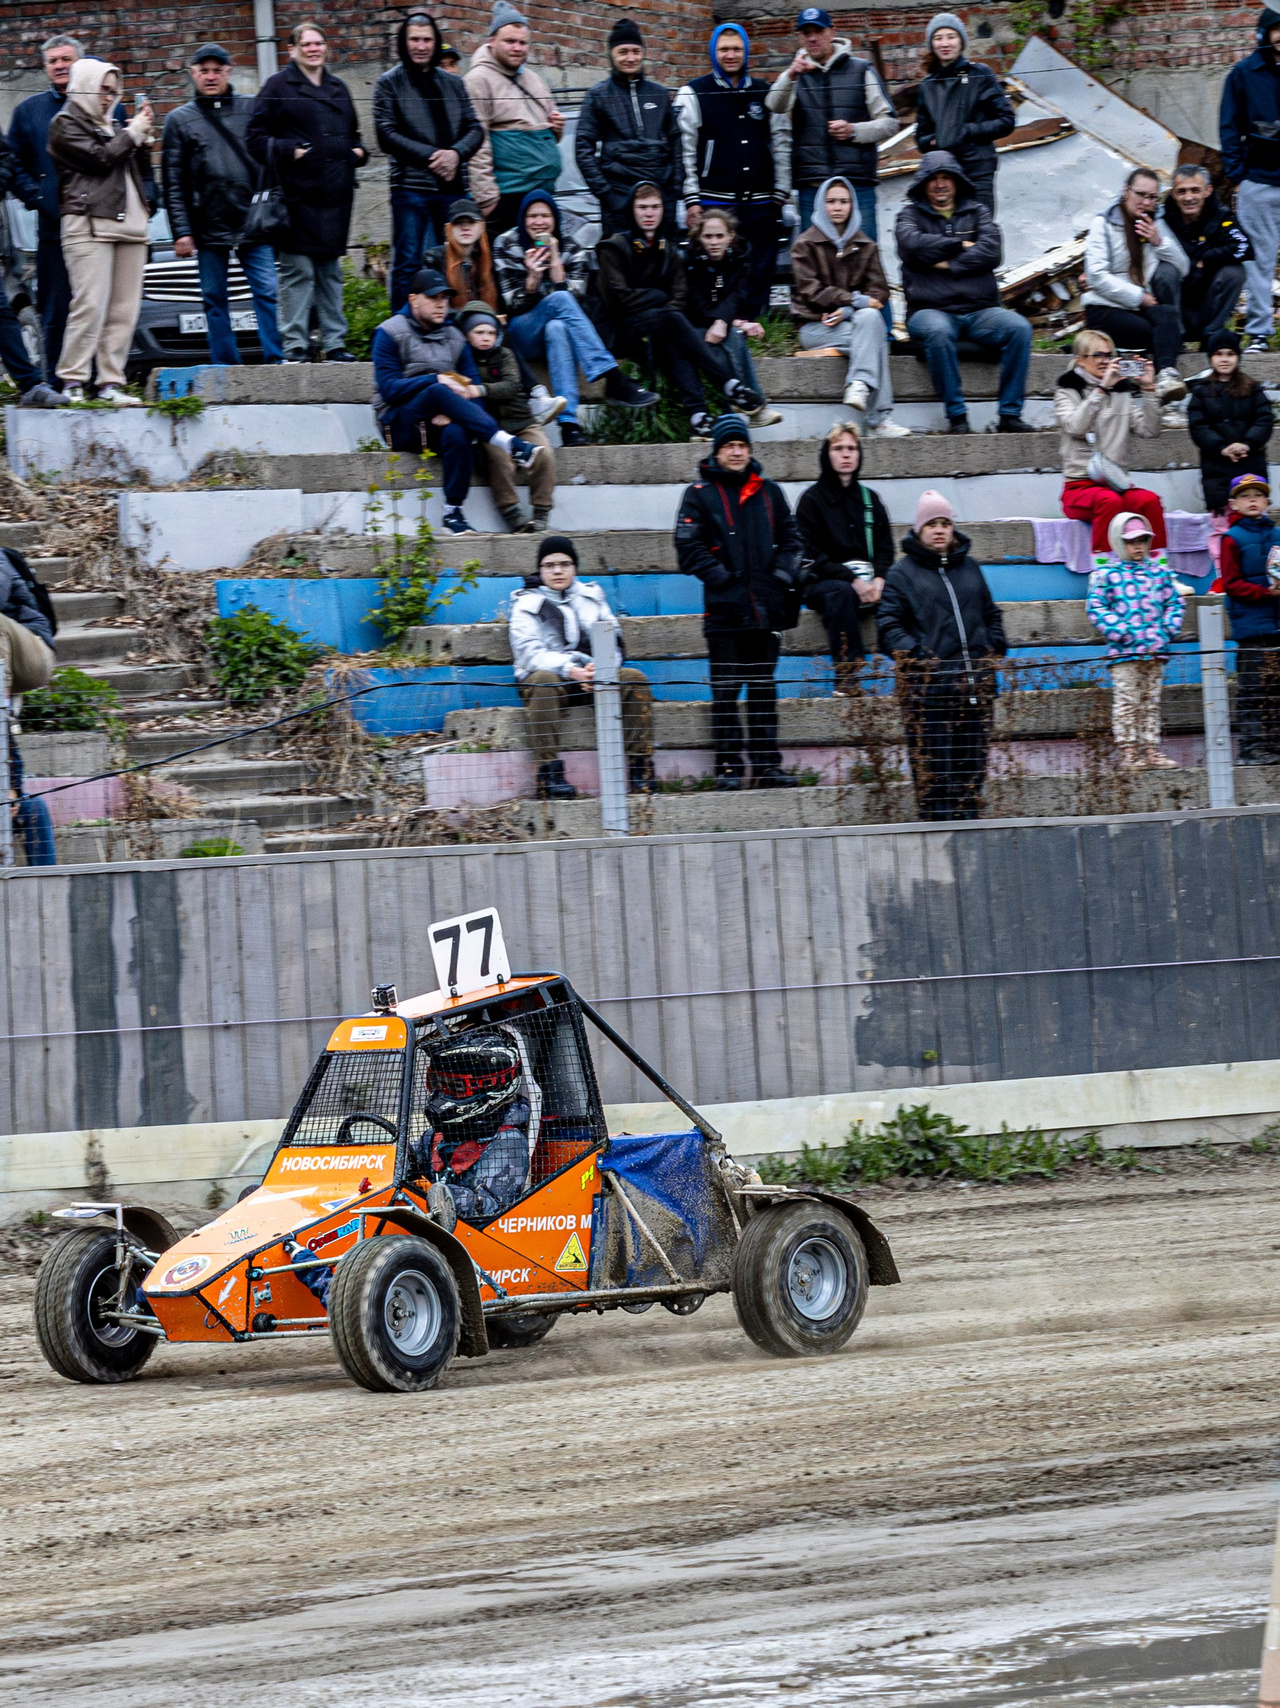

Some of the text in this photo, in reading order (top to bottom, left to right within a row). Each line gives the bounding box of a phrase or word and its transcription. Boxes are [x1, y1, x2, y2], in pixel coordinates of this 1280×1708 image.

[433, 914, 494, 987] 77
[280, 1154, 386, 1173] НОВОСИБИРСК
[498, 1214, 577, 1233] ЧЕРНИКОВ
